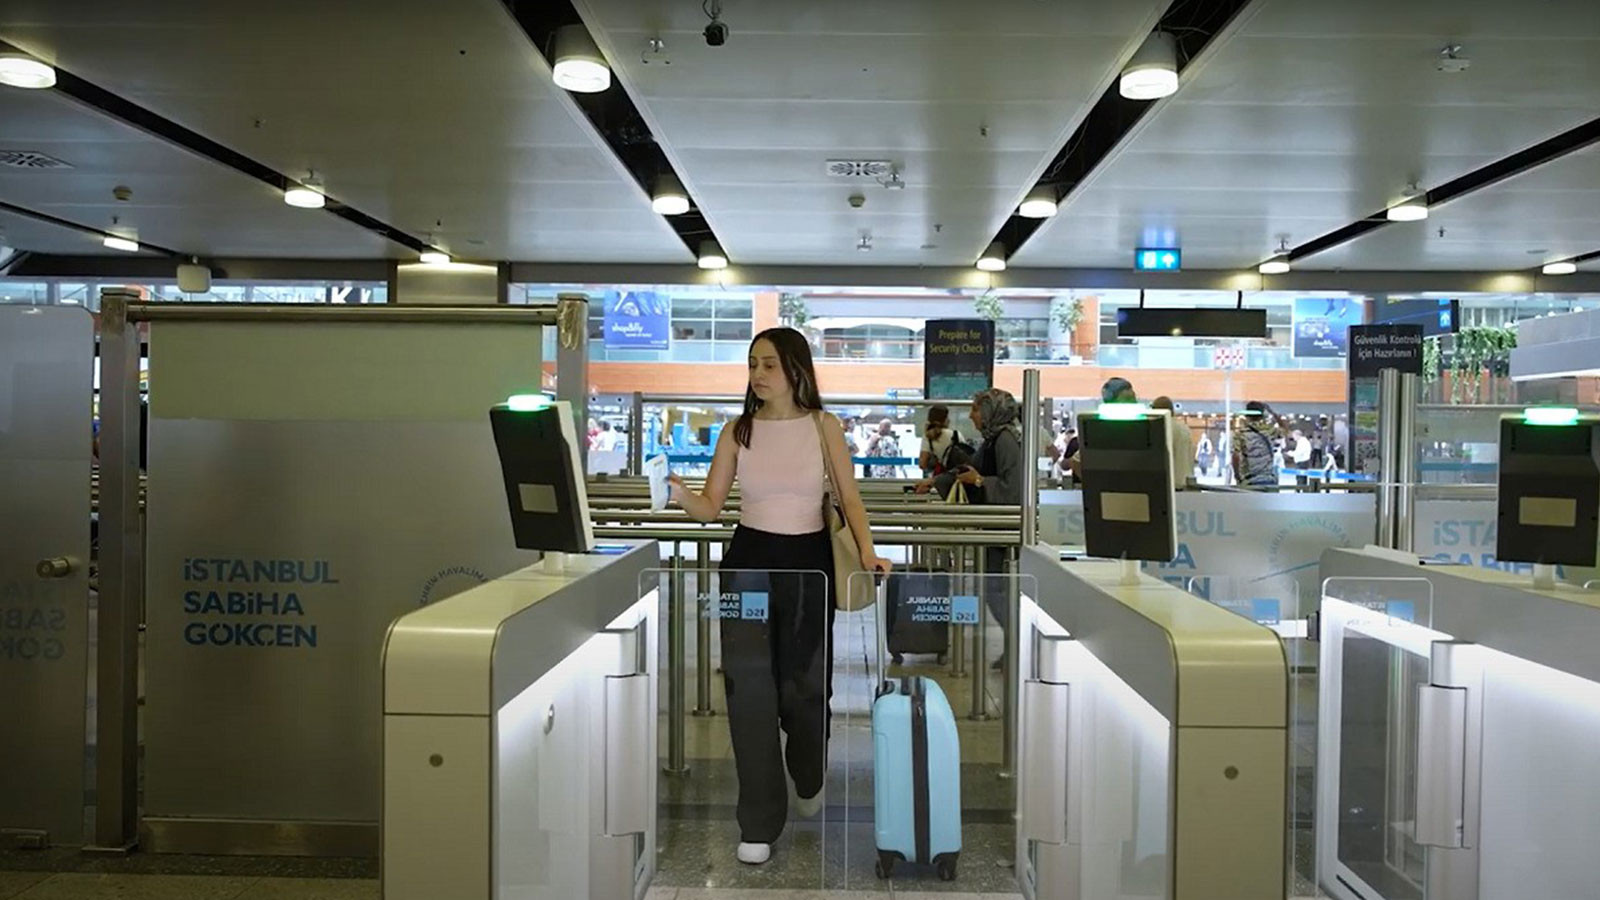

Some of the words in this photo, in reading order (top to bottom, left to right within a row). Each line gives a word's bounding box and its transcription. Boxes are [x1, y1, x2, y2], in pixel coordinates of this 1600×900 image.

[938, 328, 967, 341] Prepare
[969, 328, 981, 339] for
[929, 343, 960, 356] Security
[961, 343, 984, 354] Check
[184, 590, 304, 615] SABiHA
